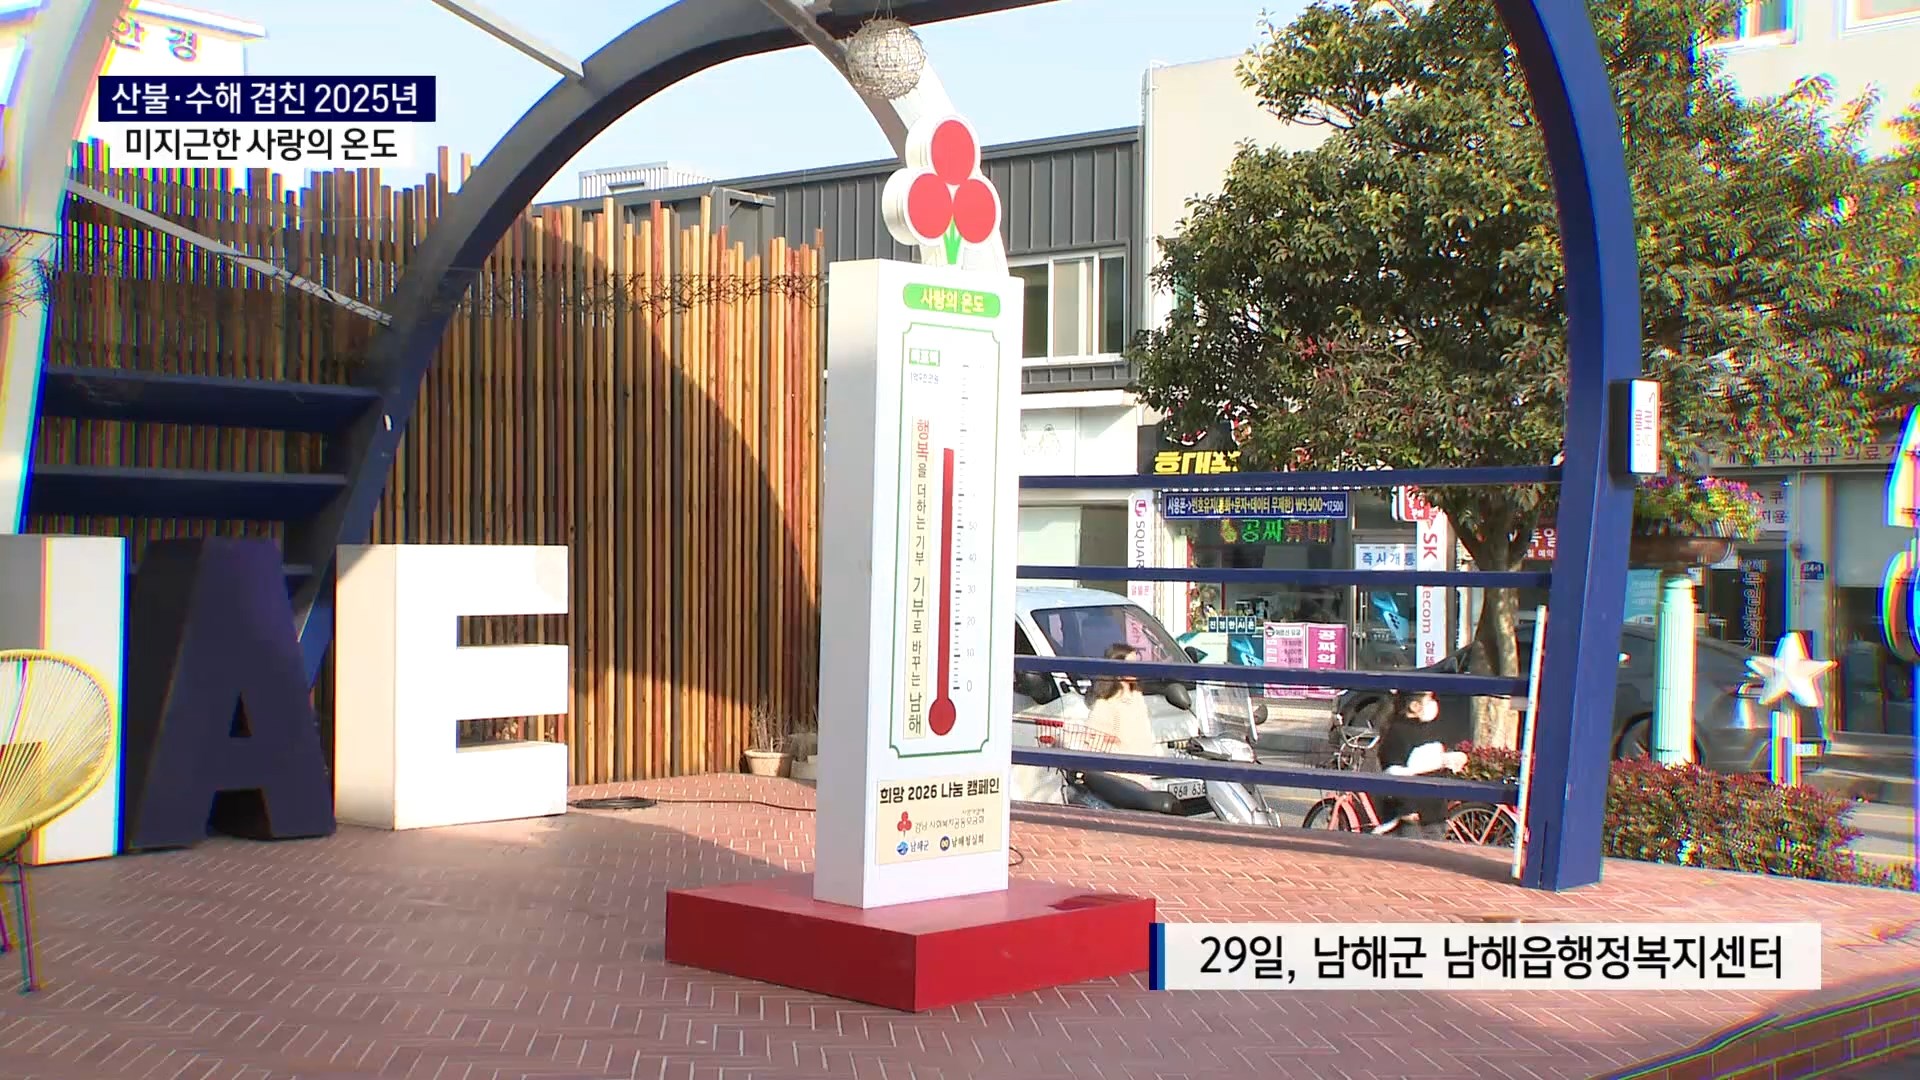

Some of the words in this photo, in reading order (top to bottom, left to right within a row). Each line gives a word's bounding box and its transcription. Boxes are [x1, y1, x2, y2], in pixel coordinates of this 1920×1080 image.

[920, 287, 958, 311] 사랑의
[961, 293, 985, 313] 온도
[916, 419, 930, 478] 행복을
[916, 483, 927, 530] 더하는
[915, 536, 925, 566] 기부
[1134, 521, 1146, 568] SQUAR
[1423, 533, 1438, 560] SK
[912, 576, 926, 633] 기부로
[911, 640, 922, 687] 바꾸는
[966, 679, 973, 692] 0
[908, 692, 922, 735] 남해
[879, 786, 904, 804] 희망
[908, 784, 938, 800] 2026
[941, 781, 963, 798] 나눔
[967, 778, 1000, 796] 캠페인
[910, 839, 929, 853] 남해군
